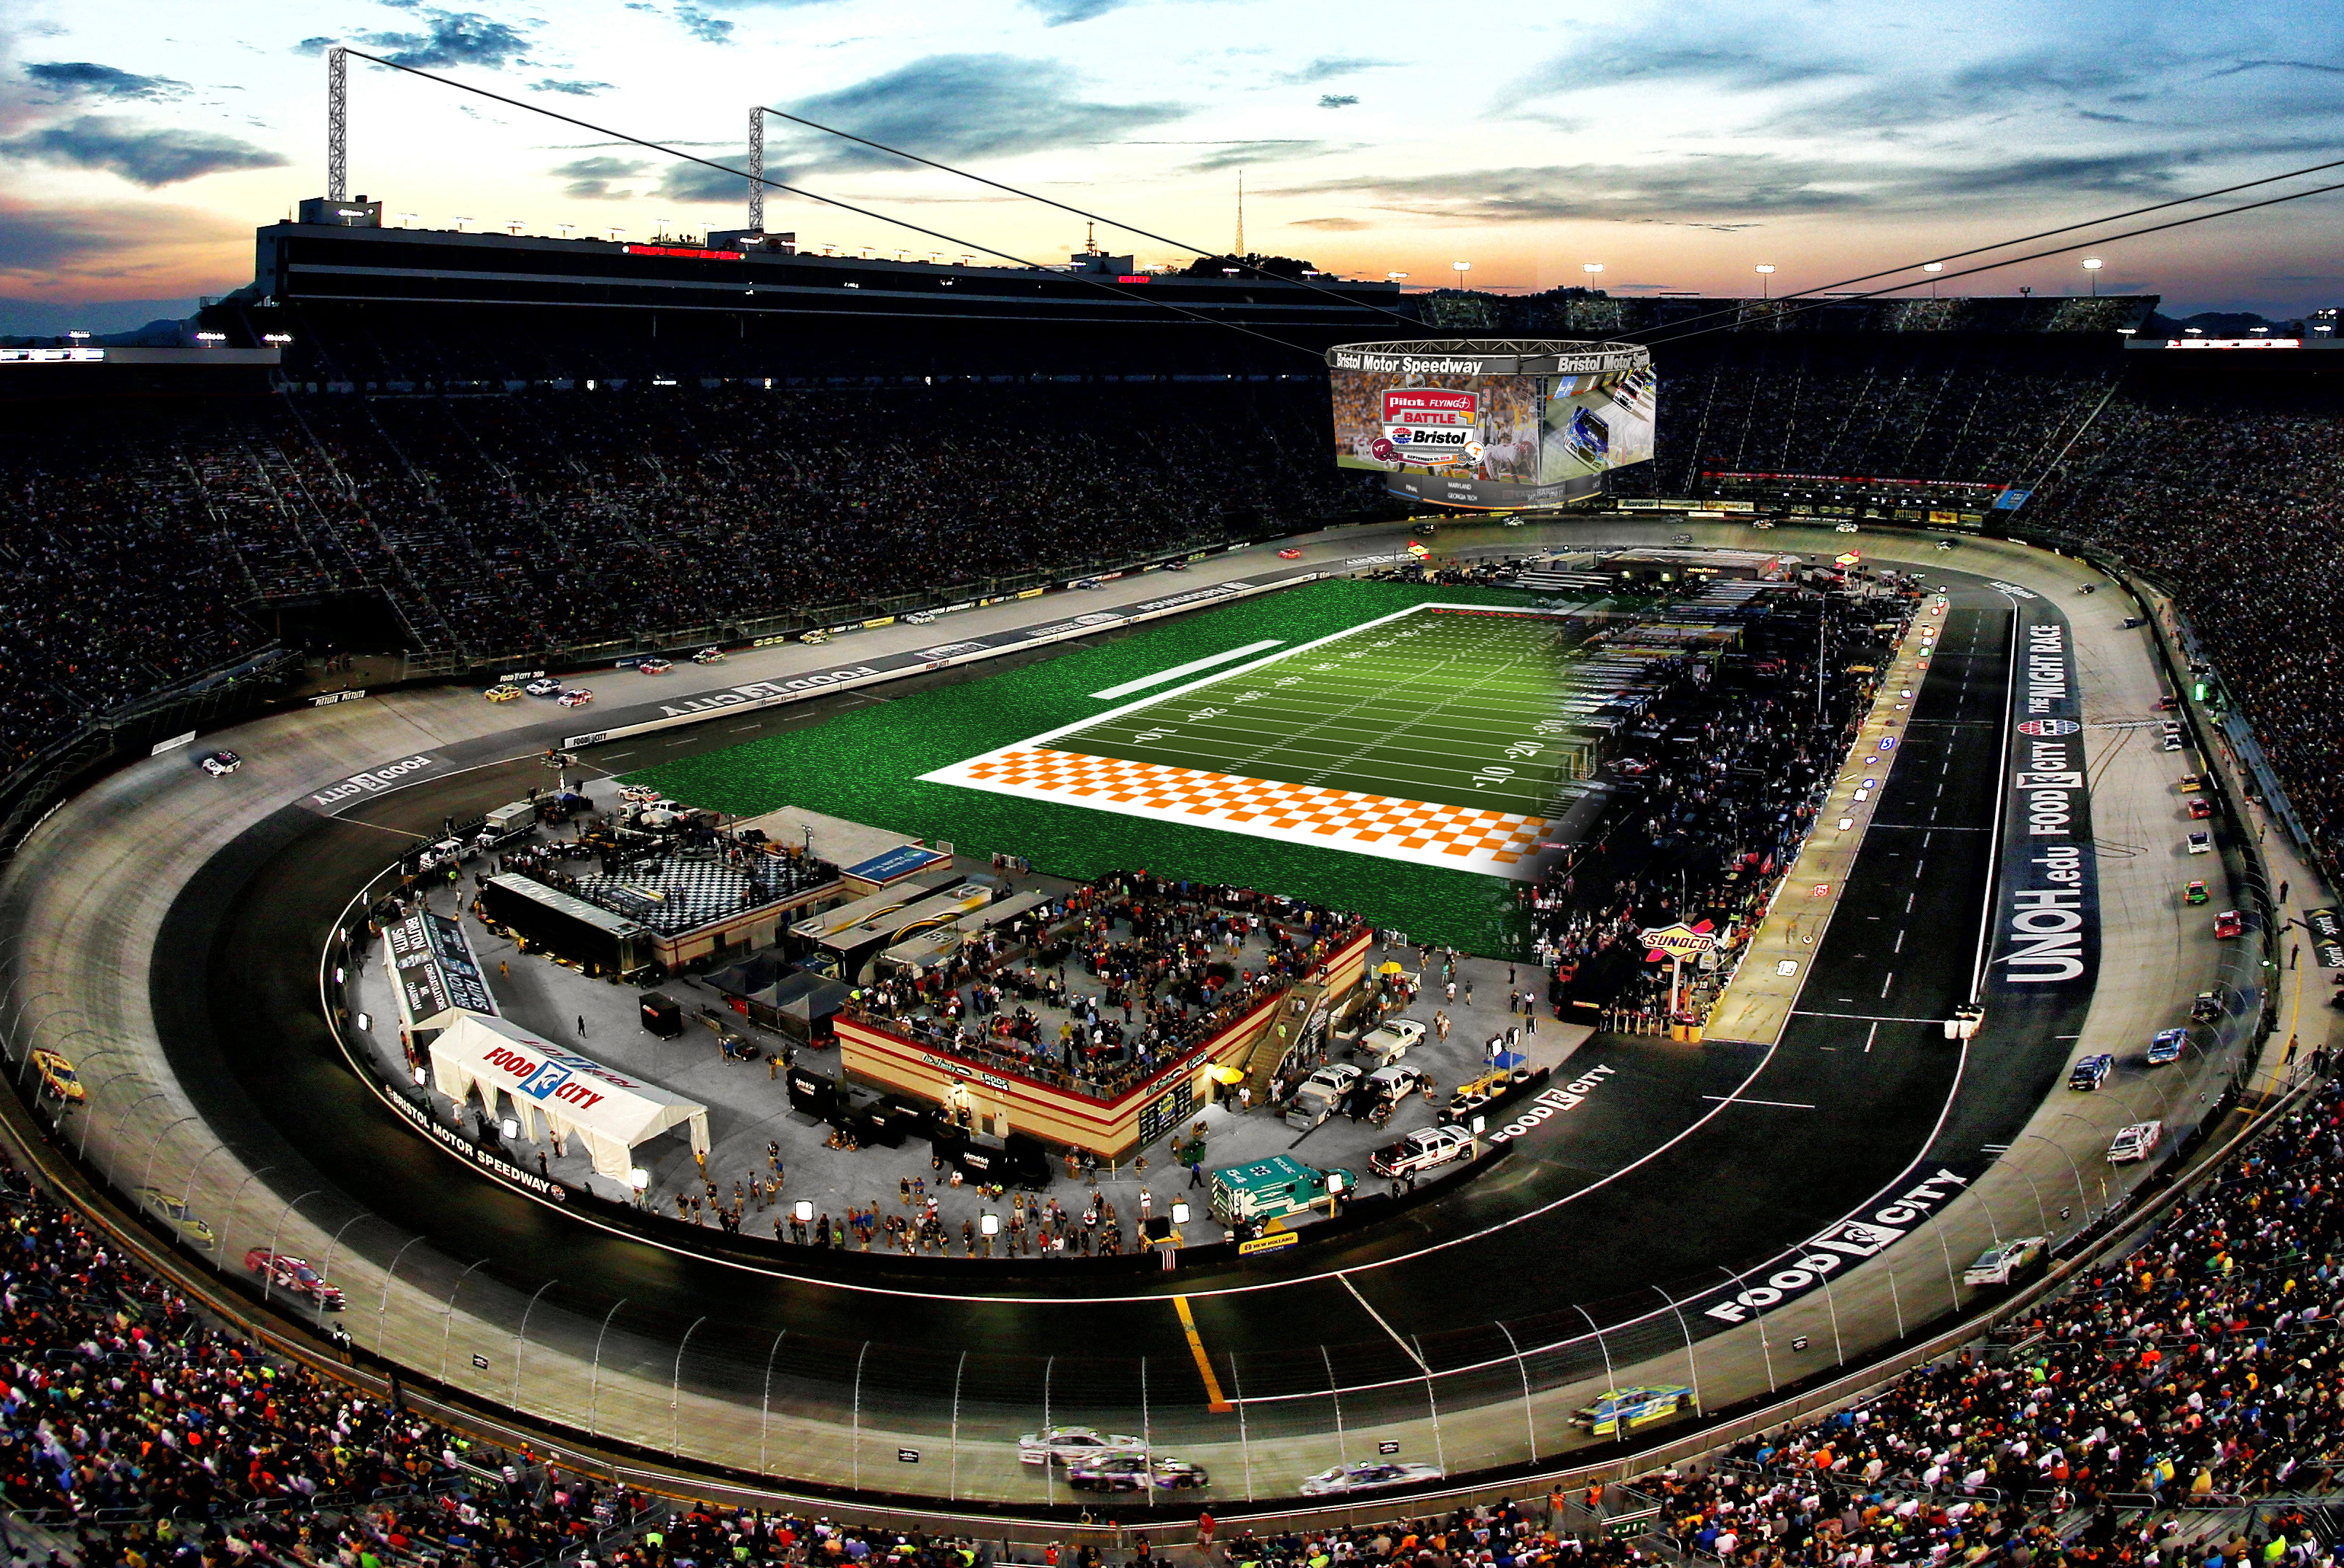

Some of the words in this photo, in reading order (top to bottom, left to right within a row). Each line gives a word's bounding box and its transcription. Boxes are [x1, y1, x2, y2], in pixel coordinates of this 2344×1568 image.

[1337, 353, 1360, 369] Bristol
[1363, 355, 1400, 372] Motor
[1402, 357, 1483, 376] Speedway
[1557, 356, 1602, 372] Bristol
[1604, 354, 1633, 370] Motor
[1389, 397, 1424, 408] Pilot
[1403, 412, 1456, 424] BATTLE
[1413, 430, 1467, 444] Bristol
[1407, 454, 1433, 462] SEPTEMBER
[1406, 484, 1418, 493] FINAL
[1448, 482, 1472, 490] MARYLAND
[1447, 493, 1465, 501] GEORGIA
[2029, 624, 2063, 653] RACE
[785, 665, 881, 693] FOOD
[2028, 654, 2066, 699] NIGHT
[660, 694, 746, 717] CITY
[1234, 690, 1271, 701] 30
[2028, 697, 2050, 713] THE
[1188, 707, 1228, 719] 20
[1134, 726, 1178, 740] 10
[1533, 719, 1569, 733] 30
[573, 736, 589, 746] FOOD
[595, 732, 608, 742] CITY
[1504, 741, 1545, 757] 20
[2031, 741, 2068, 772] CITY
[377, 756, 432, 780] FOOD
[1472, 766, 1516, 785] 10
[312, 783, 361, 806] CITY
[2029, 790, 2071, 836] FOOD
[2004, 846, 2084, 983] UNOH.edu
[391, 927, 409, 954] SMITH
[404, 916, 428, 951] BRUTON
[1646, 934, 1710, 950] SUNOCO
[406, 981, 423, 1011] CHAIRMAN
[423, 963, 448, 1011] CONGRATULATIONS
[483, 1046, 537, 1078] FOOD
[555, 1081, 605, 1110] CITY
[1489, 1105, 1555, 1143] FOOD
[1567, 1064, 1616, 1094] CITY
[393, 1090, 432, 1130] BRISTOL
[432, 1122, 475, 1157] MOTOR
[477, 1149, 552, 1195] SPEEDWAY
[1267, 1236, 1294, 1247] HOLLAND
[1704, 1253, 1841, 1322] FOOD
[1875, 1167, 1967, 1225] CITY
